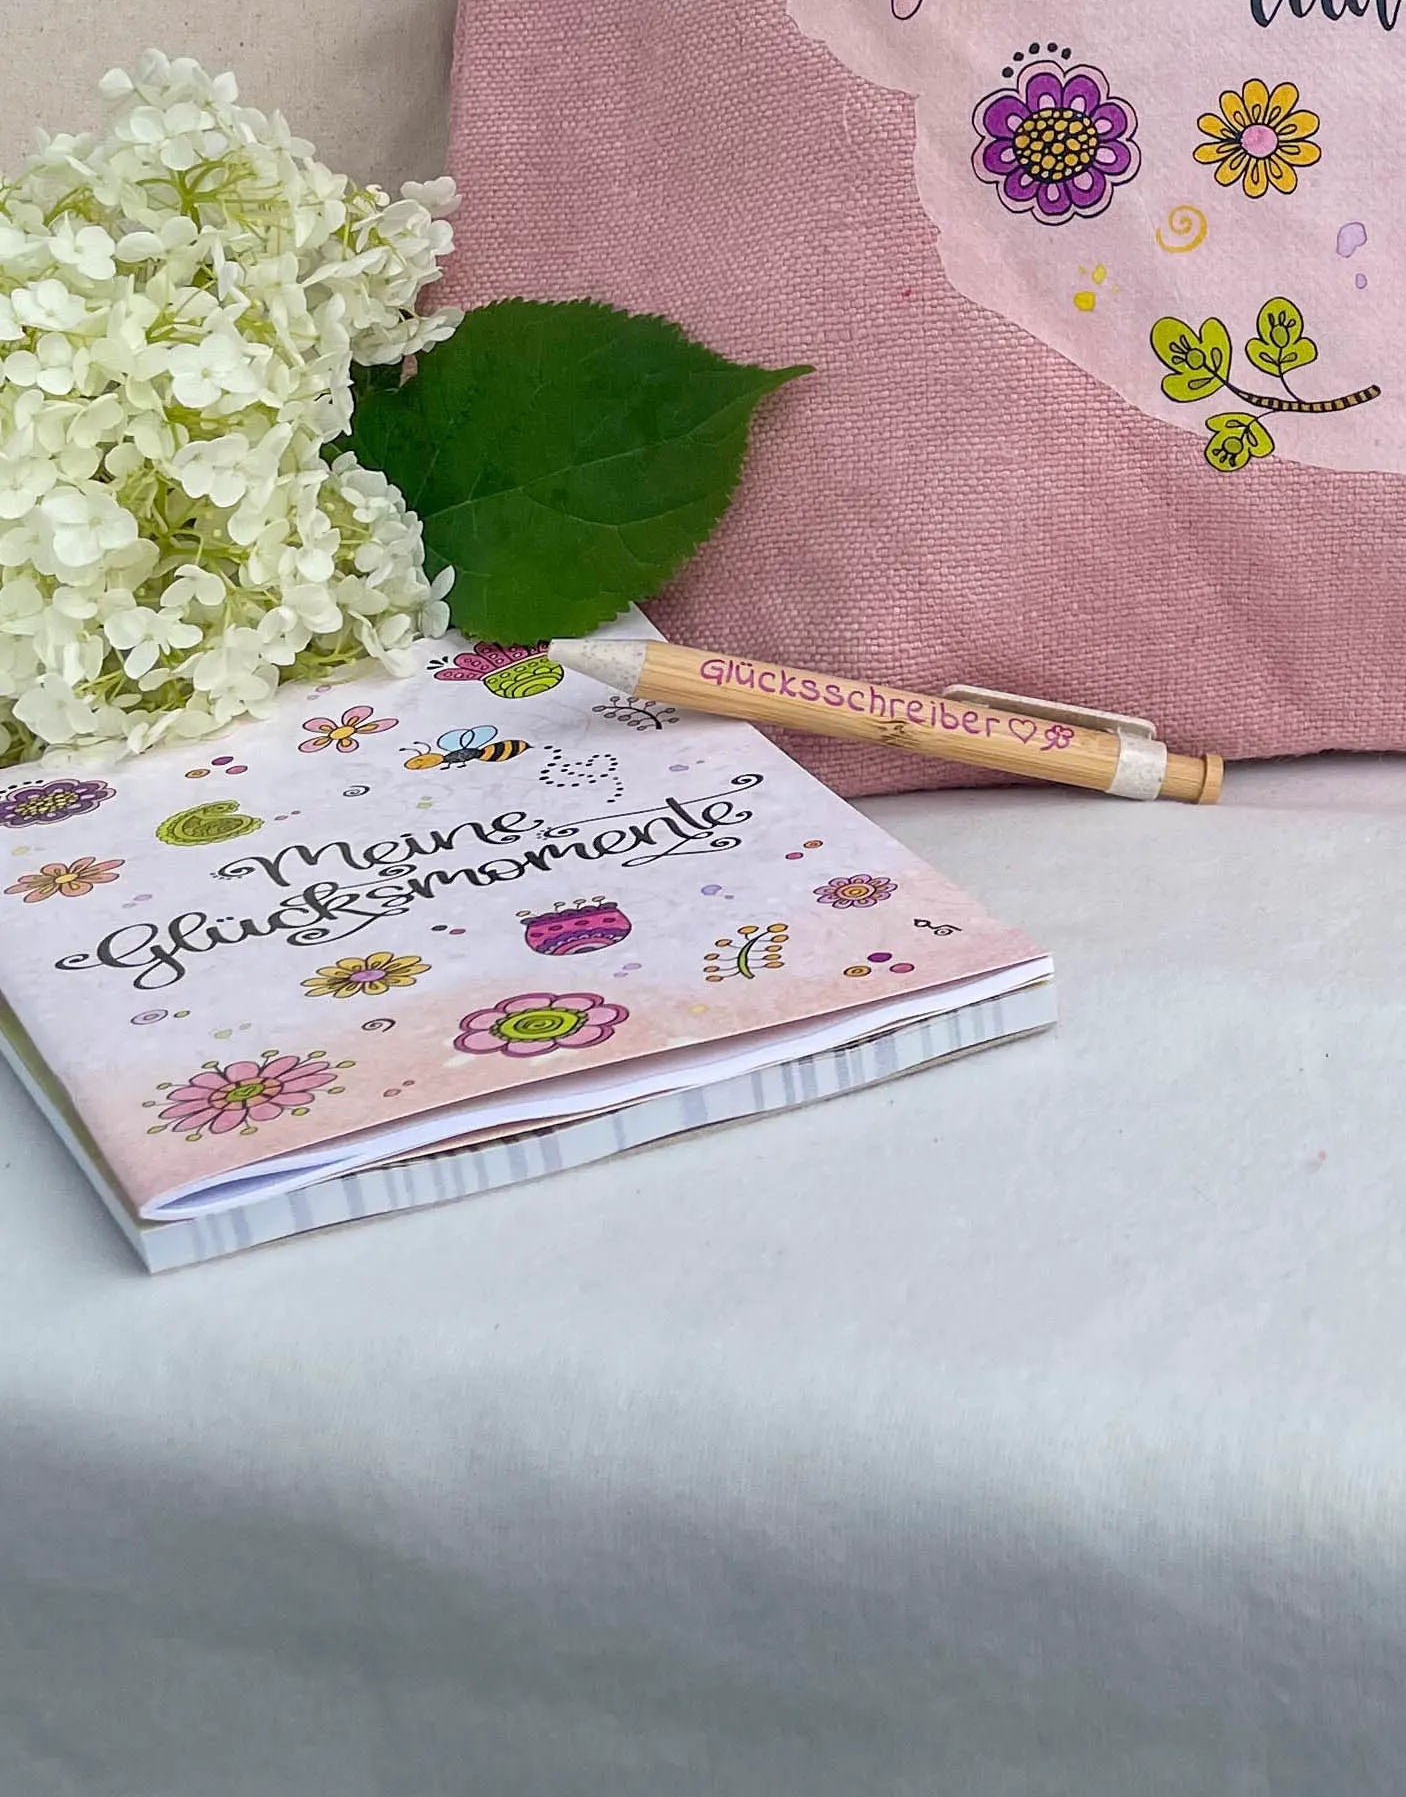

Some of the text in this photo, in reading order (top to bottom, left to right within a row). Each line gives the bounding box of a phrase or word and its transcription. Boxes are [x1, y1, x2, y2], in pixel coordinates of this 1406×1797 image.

[699, 656, 1000, 740] Glücksschreiber
[55, 772, 764, 990] Glücksmomente
[210, 810, 545, 888] Meine
